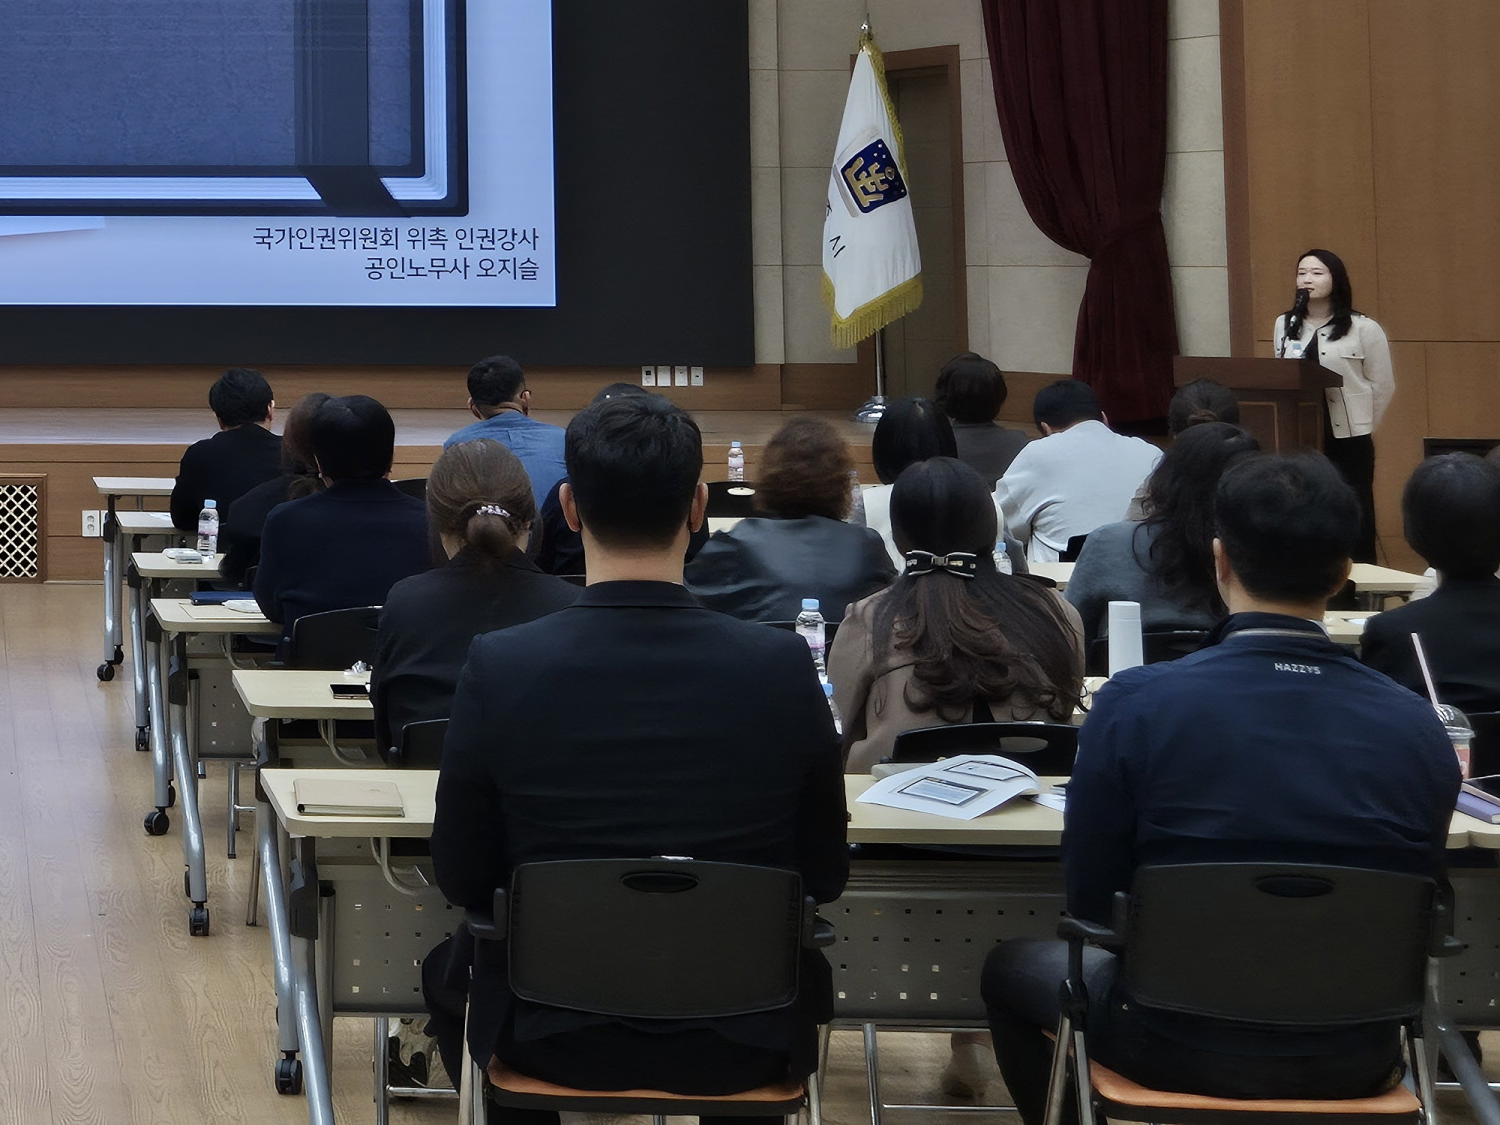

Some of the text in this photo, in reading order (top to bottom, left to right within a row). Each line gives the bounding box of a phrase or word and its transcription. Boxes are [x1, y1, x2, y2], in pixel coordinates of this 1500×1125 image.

[252, 226, 540, 252] 국가인권위원회 위촉 인권강사
[364, 256, 540, 282] 공인노무사 오지슬
[1274, 662, 1321, 675] HAZZYS
